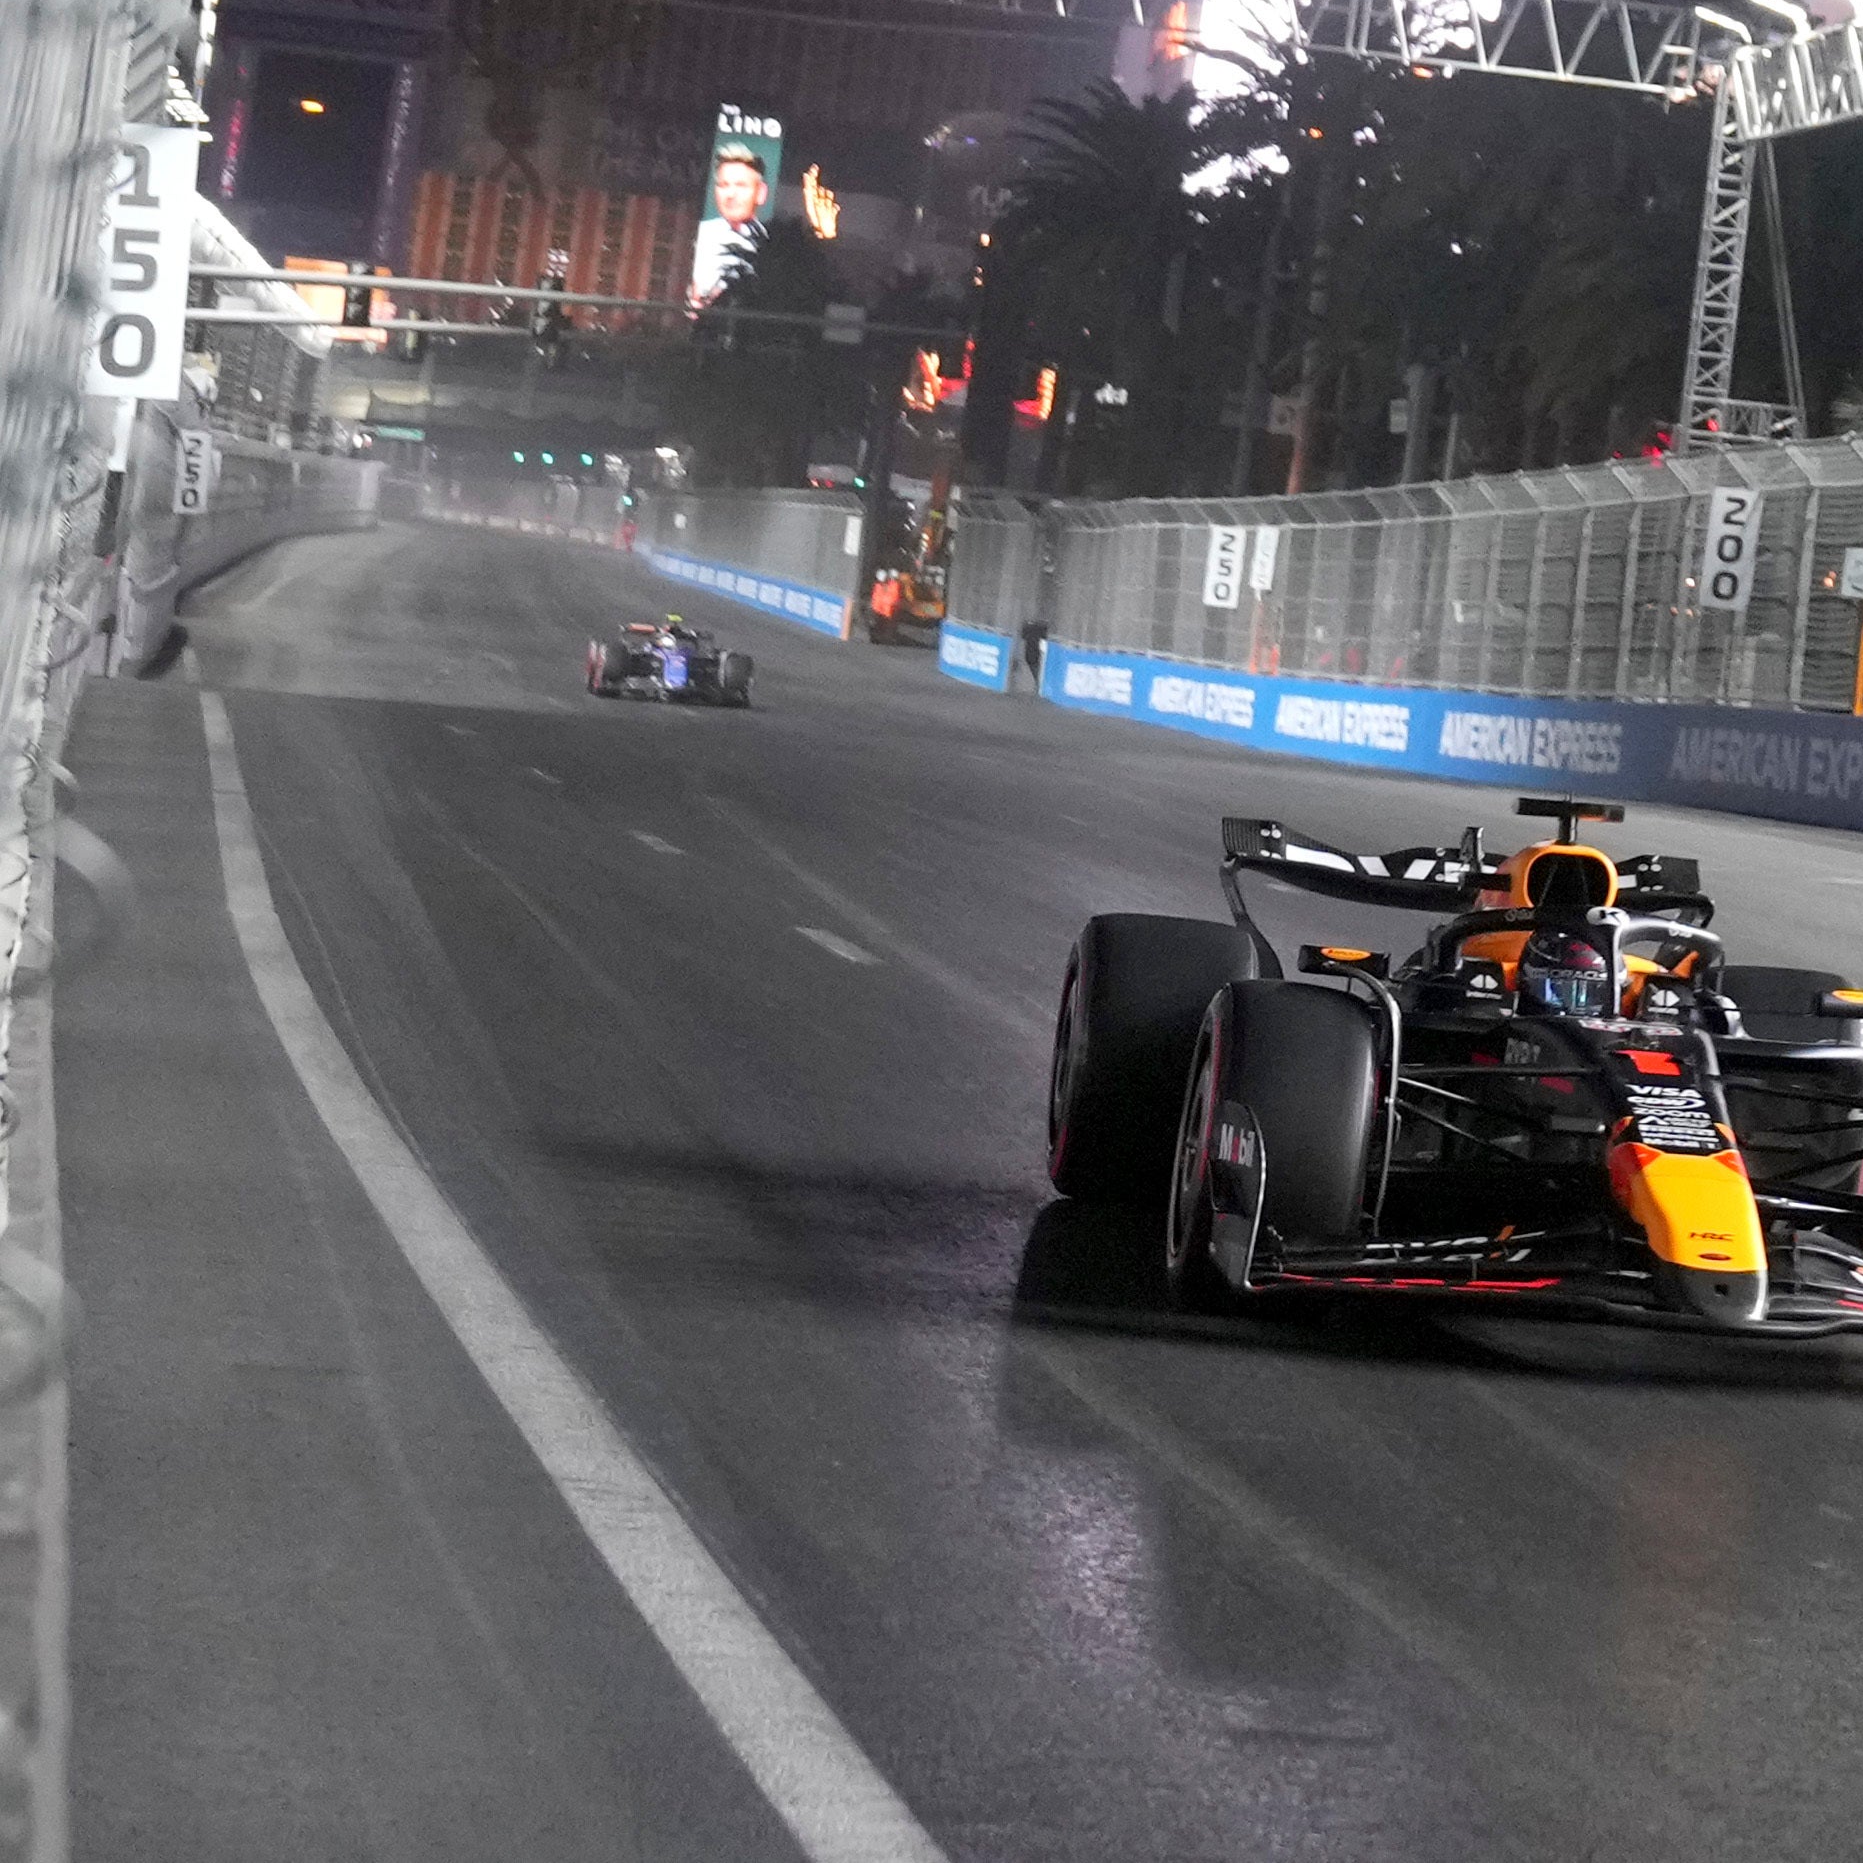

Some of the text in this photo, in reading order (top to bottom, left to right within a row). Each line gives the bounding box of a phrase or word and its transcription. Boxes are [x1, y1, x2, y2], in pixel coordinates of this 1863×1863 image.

[99, 140, 160, 378] 150
[1211, 533, 1234, 600] 250
[1711, 496, 1746, 601] 200
[1437, 710, 1622, 774] AMERICAN EXPRESS
[1668, 728, 1799, 793] AMERICAN
[1625, 1084, 1702, 1098] VISA
[1688, 1231, 1737, 1242] HRC
